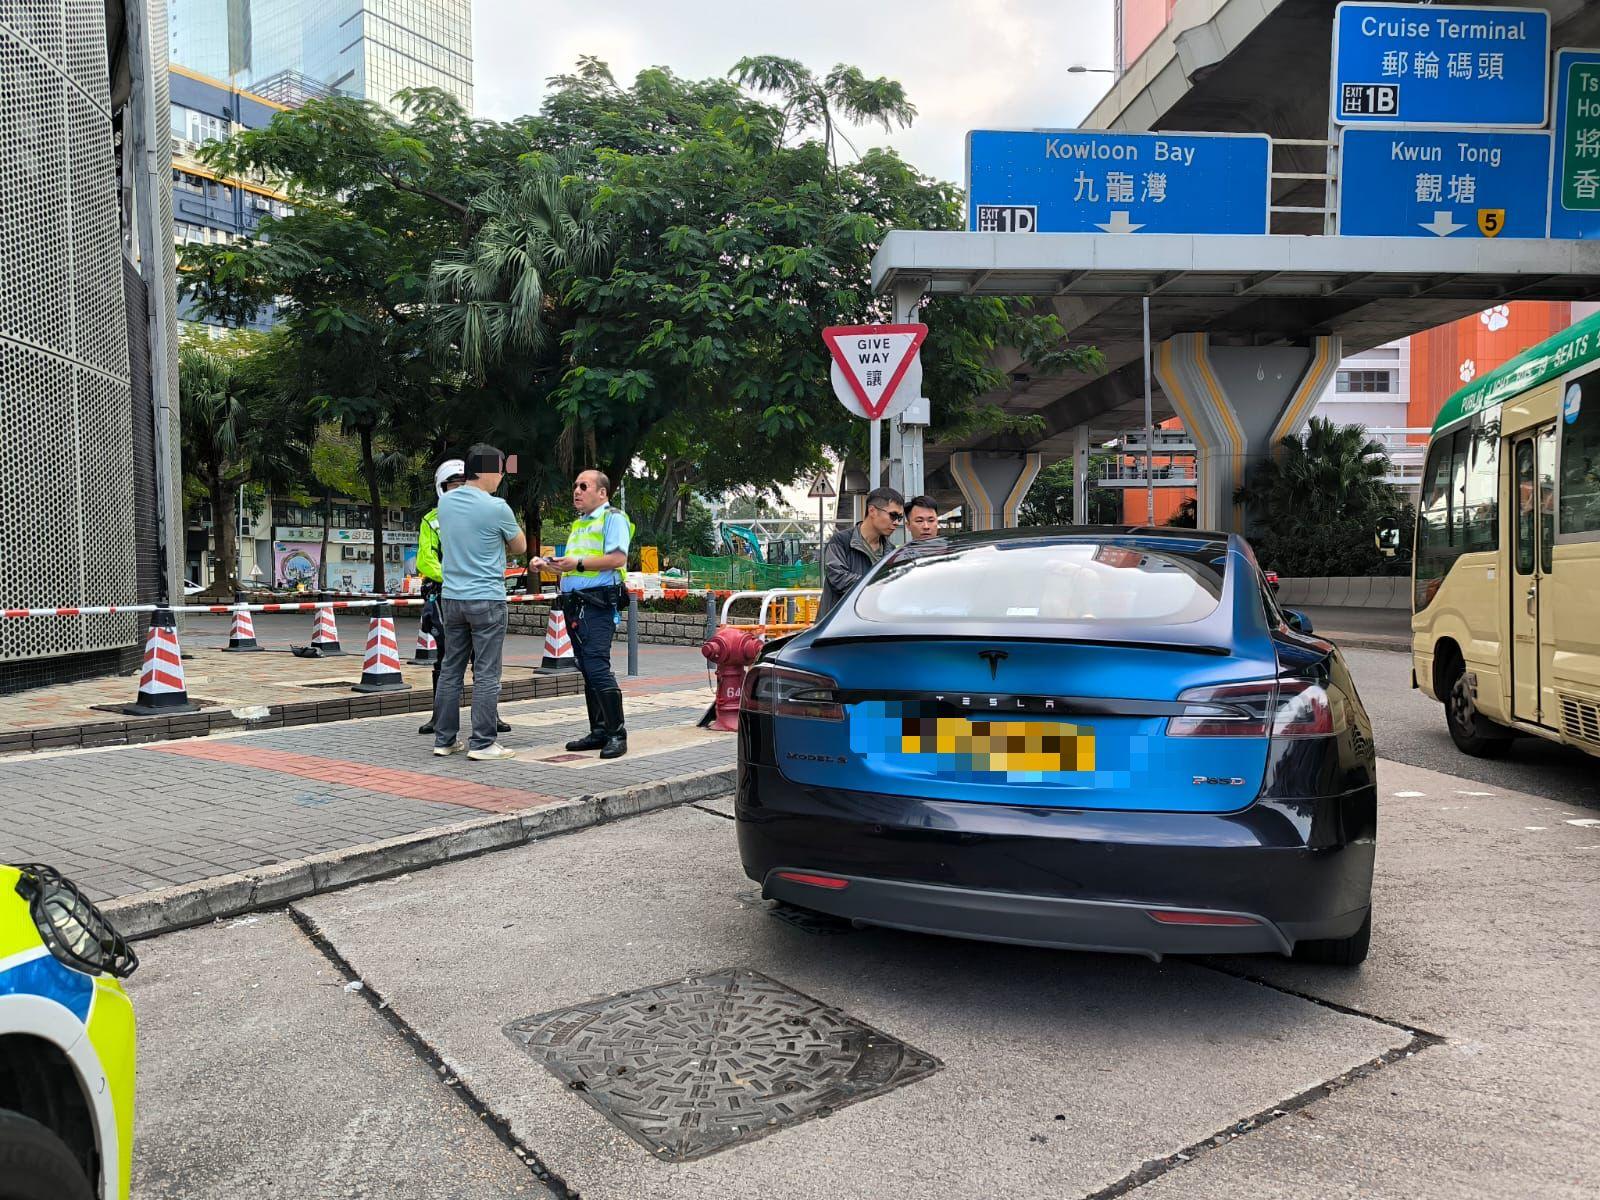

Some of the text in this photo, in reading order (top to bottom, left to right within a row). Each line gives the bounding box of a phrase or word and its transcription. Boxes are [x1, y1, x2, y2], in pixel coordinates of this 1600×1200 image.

[1361, 16, 1526, 40] Cruise Terminal
[1381, 50, 1504, 81] 郵輪碼頭
[1345, 86, 1363, 98] EXIT
[1366, 87, 1395, 113] 1B
[1345, 98, 1361, 112] 出
[1045, 138, 1195, 167] Kowloon Bay
[1391, 141, 1502, 167] Kwun Tong
[1073, 170, 1168, 203] 九龍灣
[1415, 173, 1476, 204] 觀塘
[981, 208, 999, 220] EXIT
[1002, 208, 1033, 232] 1D
[1484, 213, 1497, 231] 5
[857, 338, 891, 350] GIVE
[1554, 334, 1589, 367] SEATS
[858, 352, 890, 364] WAY
[866, 370, 882, 387] 讓
[936, 695, 1055, 709] TESLA
[785, 751, 834, 762] MODEL
[1192, 775, 1246, 785] P85D
